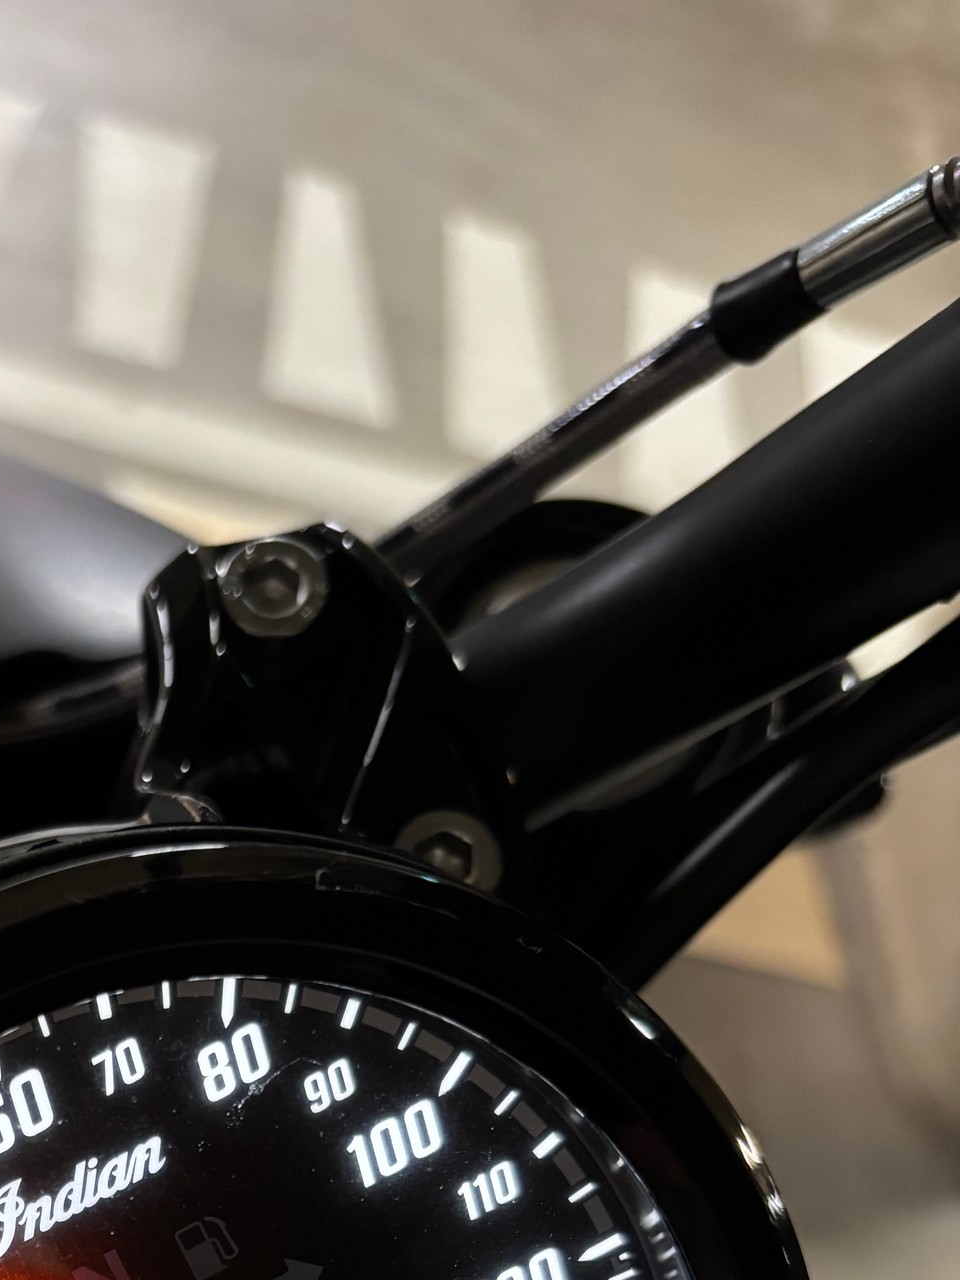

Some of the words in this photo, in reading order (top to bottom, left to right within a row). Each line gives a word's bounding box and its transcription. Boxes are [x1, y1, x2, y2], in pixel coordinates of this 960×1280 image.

[91, 1037, 147, 1097] 70
[197, 1022, 271, 1103] 80
[303, 1057, 357, 1114] 90
[345, 1099, 444, 1190] 100
[456, 1160, 523, 1222] 110
